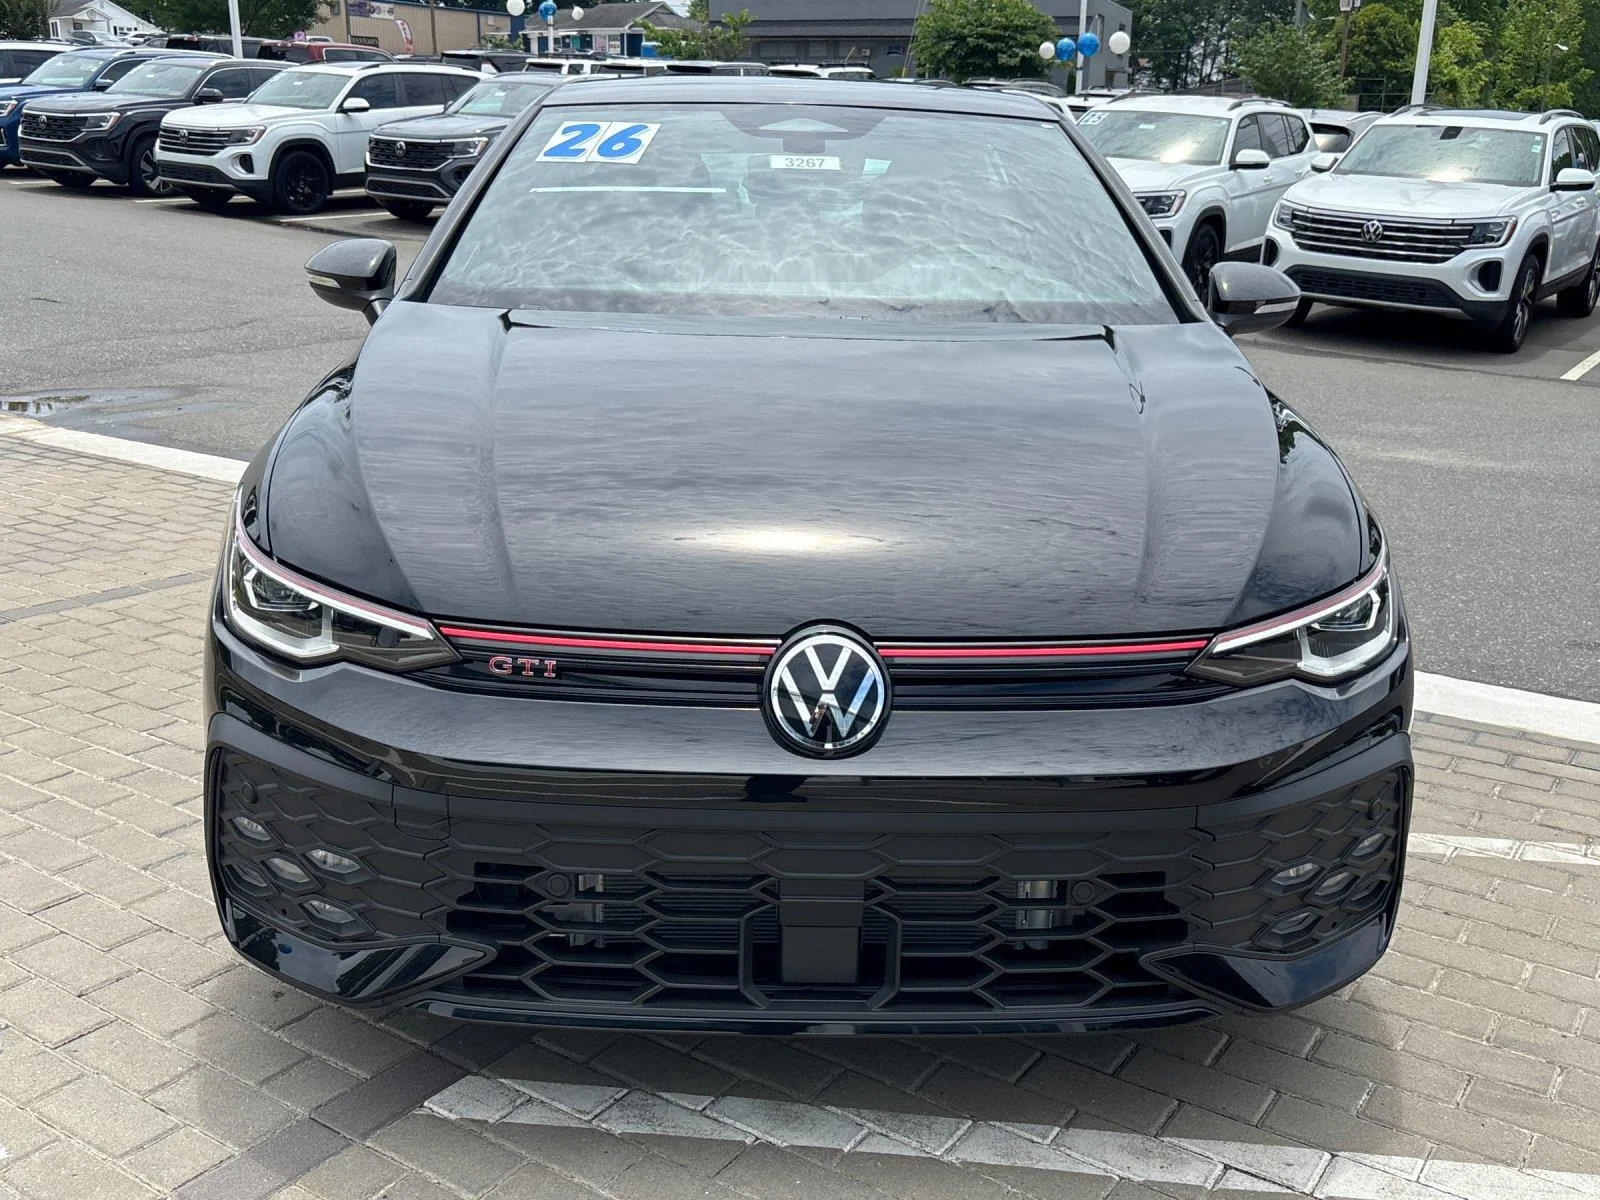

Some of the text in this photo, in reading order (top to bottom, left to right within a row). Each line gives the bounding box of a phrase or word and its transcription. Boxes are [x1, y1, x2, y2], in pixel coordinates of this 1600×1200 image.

[543, 123, 648, 158] 26
[784, 157, 825, 168] 3267
[488, 655, 556, 678] GTI
